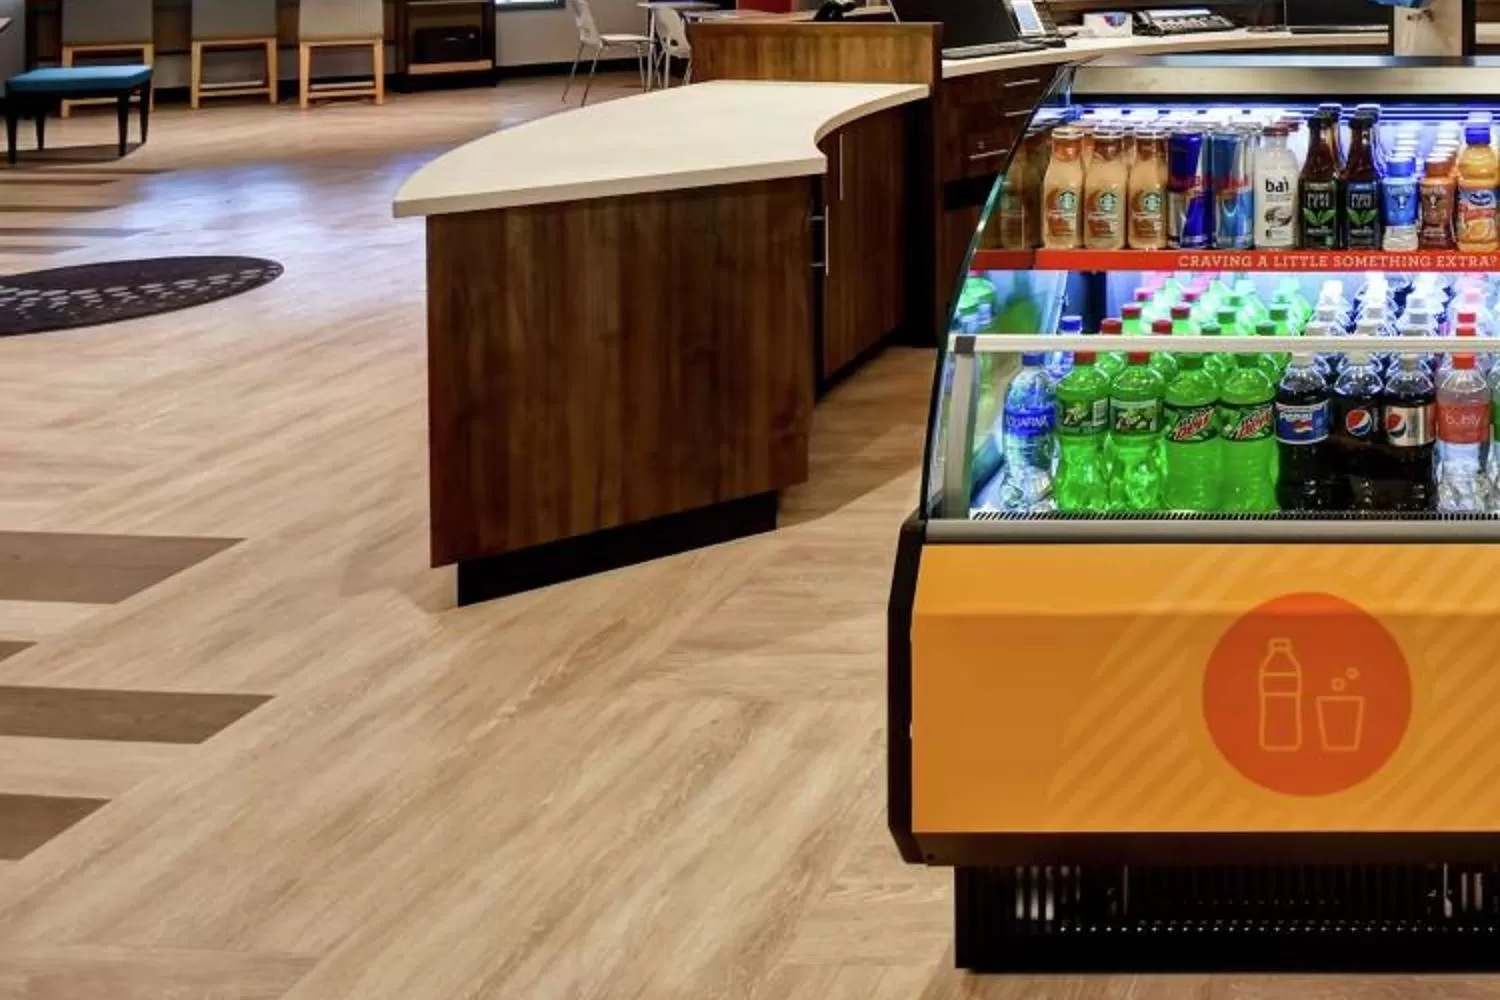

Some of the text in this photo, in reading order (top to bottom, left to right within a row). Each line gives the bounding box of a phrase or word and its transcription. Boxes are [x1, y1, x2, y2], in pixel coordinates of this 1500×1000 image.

[1265, 176, 1289, 193] bai
[1178, 255, 1497, 268] CRAVING A LITTLE SOMETHING EXTRA?
